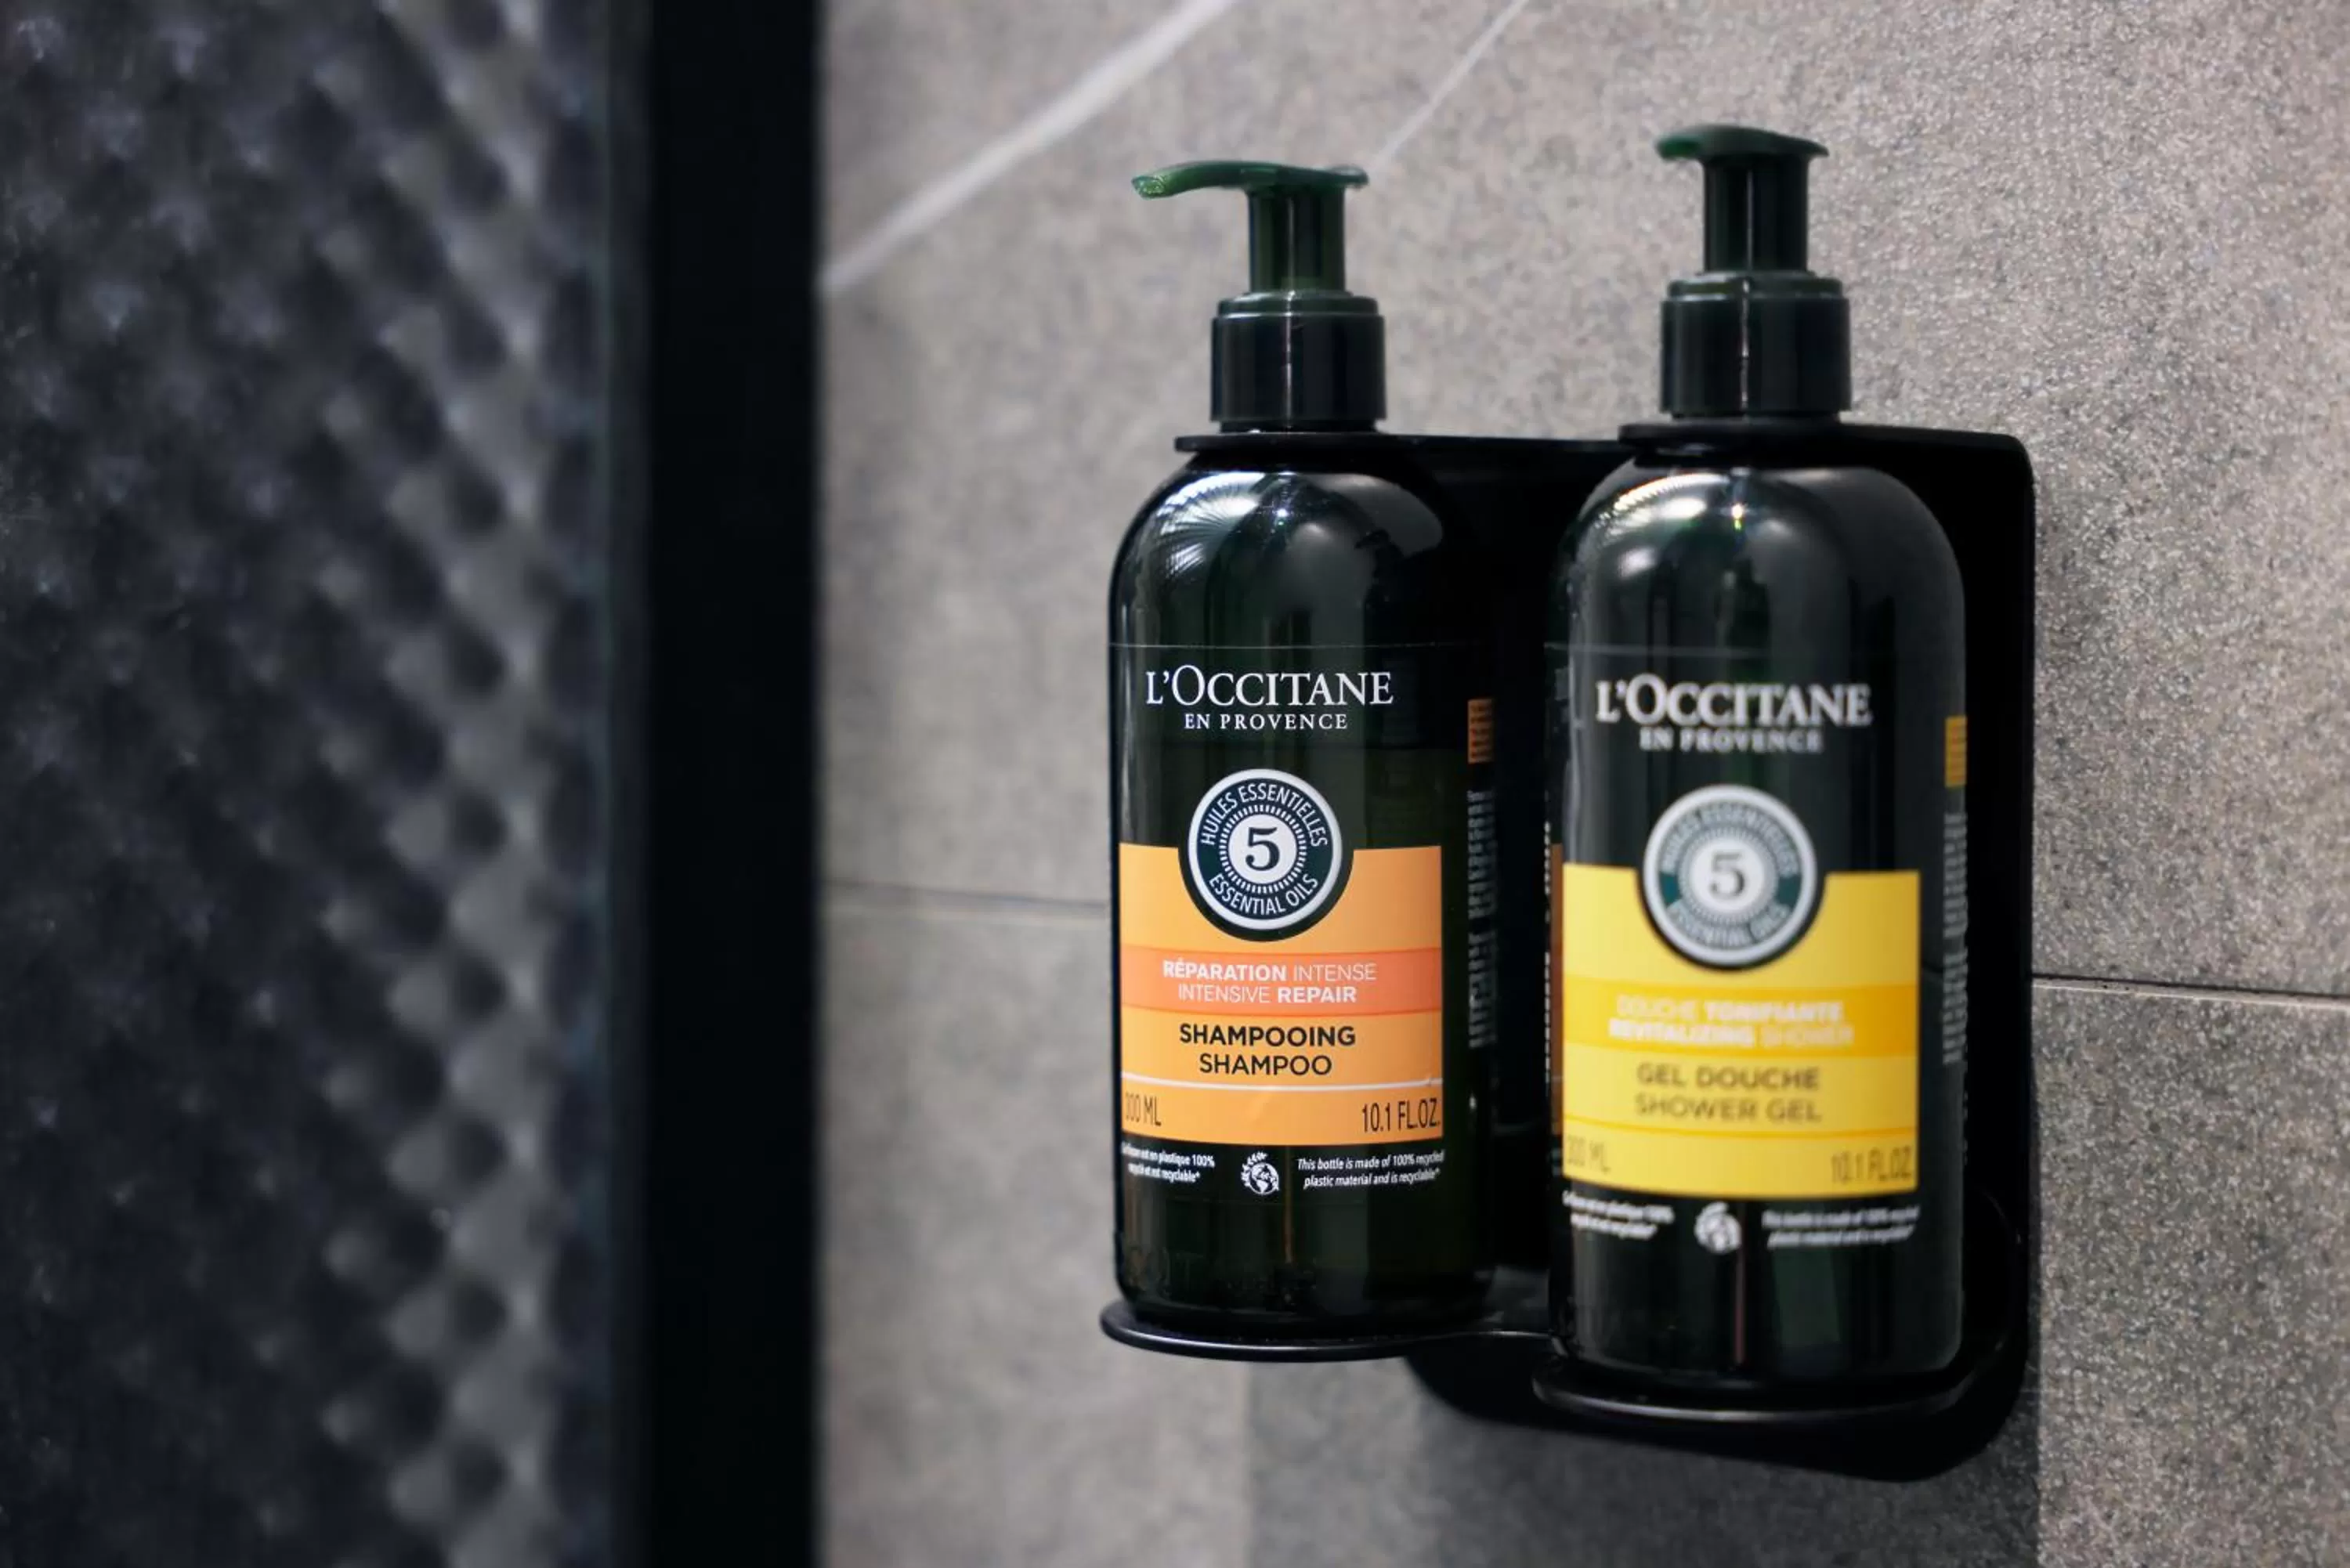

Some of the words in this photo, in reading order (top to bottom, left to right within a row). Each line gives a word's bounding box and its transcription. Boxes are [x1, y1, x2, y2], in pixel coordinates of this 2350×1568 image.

[1184, 714, 1210, 729] EN
[1220, 714, 1348, 730] PROVENCE
[1640, 728, 1674, 750] EN
[1679, 729, 1824, 753] PROVENCE
[1201, 792, 1238, 845] HUILES
[1238, 783, 1328, 847] ESSENTIELLES
[1245, 826, 1281, 871] 5
[1708, 850, 1746, 900] 5
[1209, 873, 1286, 916] ESSENTIAL
[1285, 873, 1318, 906] OILS
[1162, 957, 1286, 981] RÉPARATION
[1293, 963, 1377, 981] INTENSE
[1178, 983, 1270, 1003] INTENSIVE
[1277, 986, 1357, 1003] REPAIR
[1179, 1023, 1356, 1046] SHAMPOOING
[1199, 1054, 1332, 1075] SHAMPOO
[1636, 1061, 1686, 1086] GEL
[1697, 1065, 1820, 1089] DOUCHE
[1144, 1094, 1162, 1126] ML
[1361, 1102, 1390, 1133] 10.1
[1635, 1093, 1756, 1120] SHOWER
[1766, 1097, 1822, 1122] GEL
[1191, 1154, 1215, 1169] 100%
[1297, 1158, 1316, 1170] This
[1318, 1158, 1344, 1170] bottle
[1346, 1158, 1354, 1169] is
[1355, 1156, 1379, 1169] made
[1382, 1154, 1391, 1168] of
[1393, 1153, 1415, 1166] 100%
[1303, 1175, 1334, 1190] plastic
[1335, 1173, 1372, 1186] material
[1373, 1172, 1390, 1184] and
[1391, 1171, 1398, 1183] is
